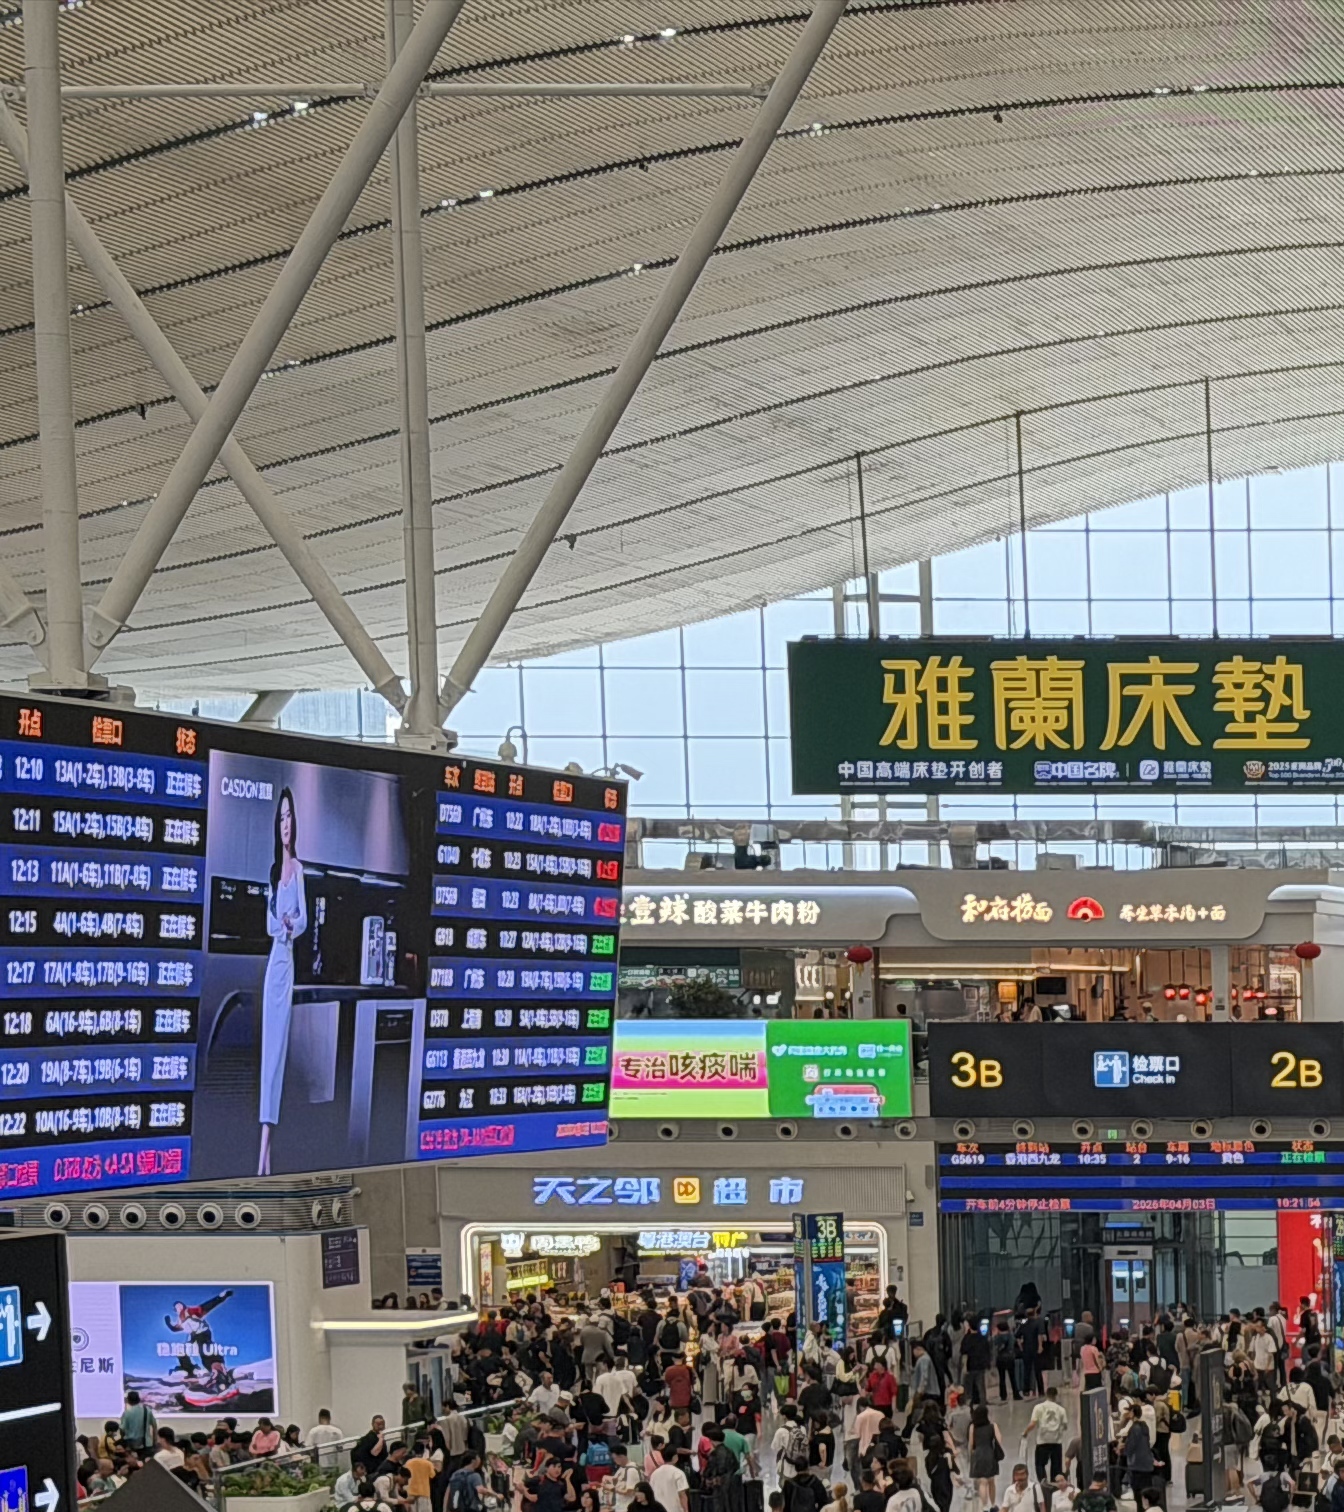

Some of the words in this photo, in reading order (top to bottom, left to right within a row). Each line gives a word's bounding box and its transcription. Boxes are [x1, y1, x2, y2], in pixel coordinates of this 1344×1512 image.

[878, 655, 1311, 752] 雅蘭床墊
[19, 708, 42, 737] 开点
[15, 756, 43, 781] 12:10
[838, 761, 1003, 779] 中国高端床垫开创者
[1051, 761, 1117, 779] 中国名牌
[13, 808, 41, 832] 12:11
[11, 859, 39, 883] 12:13
[620, 894, 821, 926] 壹辣酸菜牛肉粉
[960, 893, 1053, 923] 和府捞面
[9, 910, 37, 933] 12:15
[7, 962, 35, 984] 12:17
[4, 1012, 32, 1034] 12:18
[1, 1063, 30, 1085] 12:20
[620, 1053, 757, 1081] 专治咳痰喘
[951, 1051, 1003, 1088] 3B
[1133, 1055, 1180, 1073] 检票口
[1270, 1051, 1323, 1088] 2B
[1133, 1073, 1163, 1085] Check
[1166, 1073, 1176, 1085] in
[951, 1154, 985, 1165] G5619
[1005, 1153, 1061, 1165] 香港西九龙
[1078, 1154, 1107, 1165] 10:35
[1133, 1154, 1141, 1164] 2
[1165, 1154, 1190, 1164] 9-16
[1221, 1153, 1245, 1164] 黄色
[1280, 1151, 1326, 1164] 正在检票
[532, 1177, 660, 1204] 天之邻
[713, 1177, 804, 1204] 超市
[965, 1199, 1071, 1210] 开车前4分钟停止检票
[1132, 1199, 1216, 1210] 2026年04月03日
[817, 1220, 837, 1238] 3B
[202, 1342, 239, 1357] Ultra
[73, 1357, 115, 1374] 尼斯
